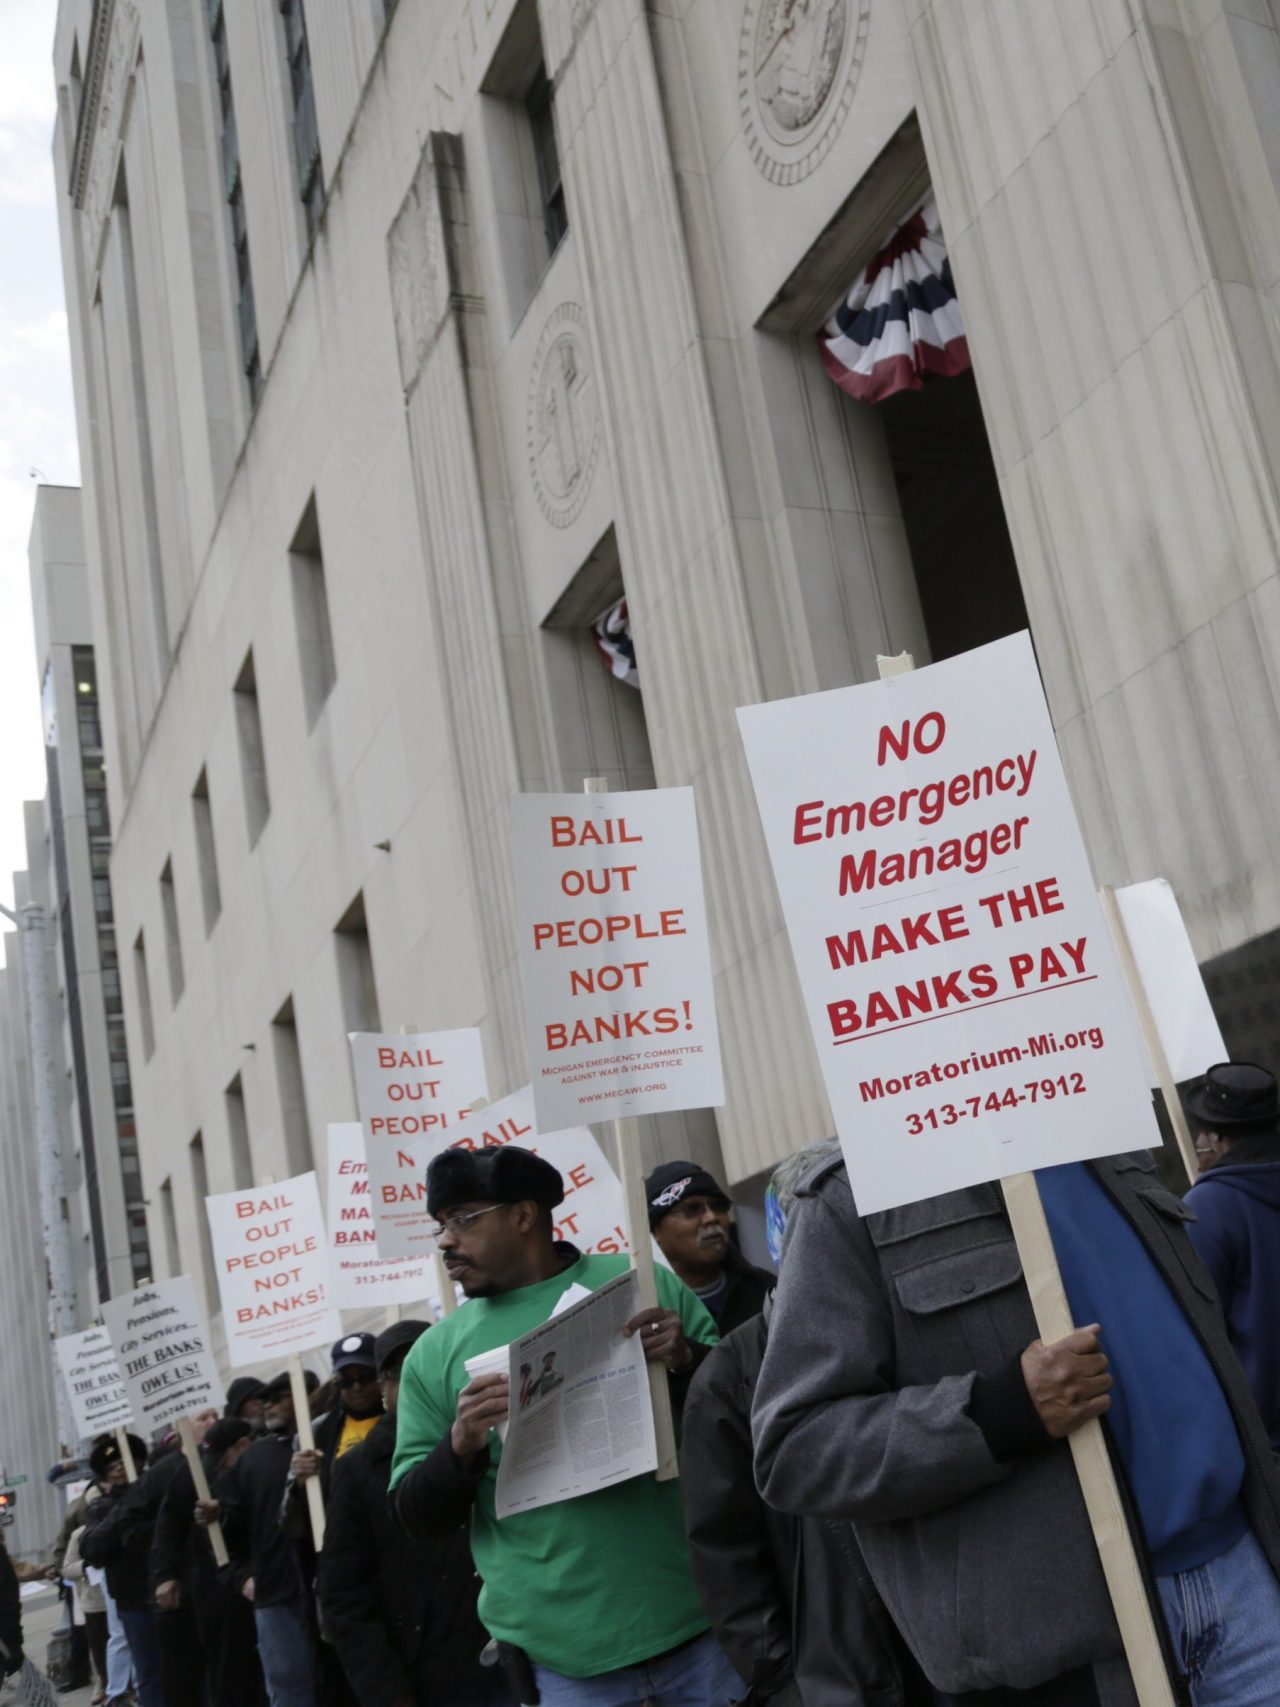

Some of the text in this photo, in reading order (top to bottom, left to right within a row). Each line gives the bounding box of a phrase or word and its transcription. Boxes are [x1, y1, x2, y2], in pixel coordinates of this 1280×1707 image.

[876, 711, 946, 766] NO
[793, 750, 1038, 845] Emergency
[550, 816, 643, 847] BAIL
[838, 816, 1030, 897] Manager
[561, 865, 637, 896] OUT
[533, 909, 686, 950] PEOPLE
[825, 877, 1065, 970] MAKE THE
[569, 961, 649, 996] NOT
[826, 937, 1089, 1038] BANKS PAY
[544, 1000, 694, 1051] BANKS!
[377, 1047, 444, 1069] BAIL
[561, 1071, 597, 1085] AGAINST
[599, 1067, 619, 1078] WAR
[630, 1058, 683, 1072] INJUSTICE
[585, 1053, 642, 1068] EMERGENCY
[644, 1045, 704, 1059] COMMITTEE
[858, 1026, 1105, 1103] Moratorium-Mi.org
[387, 1081, 441, 1101] OUT
[904, 1072, 1087, 1136] 313-744-7912
[235, 1194, 294, 1219] BAIL
[381, 1182, 428, 1204] BAN
[245, 1218, 293, 1242] OUT
[341, 1208, 370, 1221] MA
[335, 1229, 377, 1245] BAN
[226, 1236, 318, 1273] PEOPLE
[253, 1266, 303, 1292] NOT
[354, 1267, 423, 1285] 313-744-7912
[236, 1283, 326, 1323] BANKS!
[125, 1337, 203, 1375] THE BANKS
[141, 1371, 171, 1394] OWE
